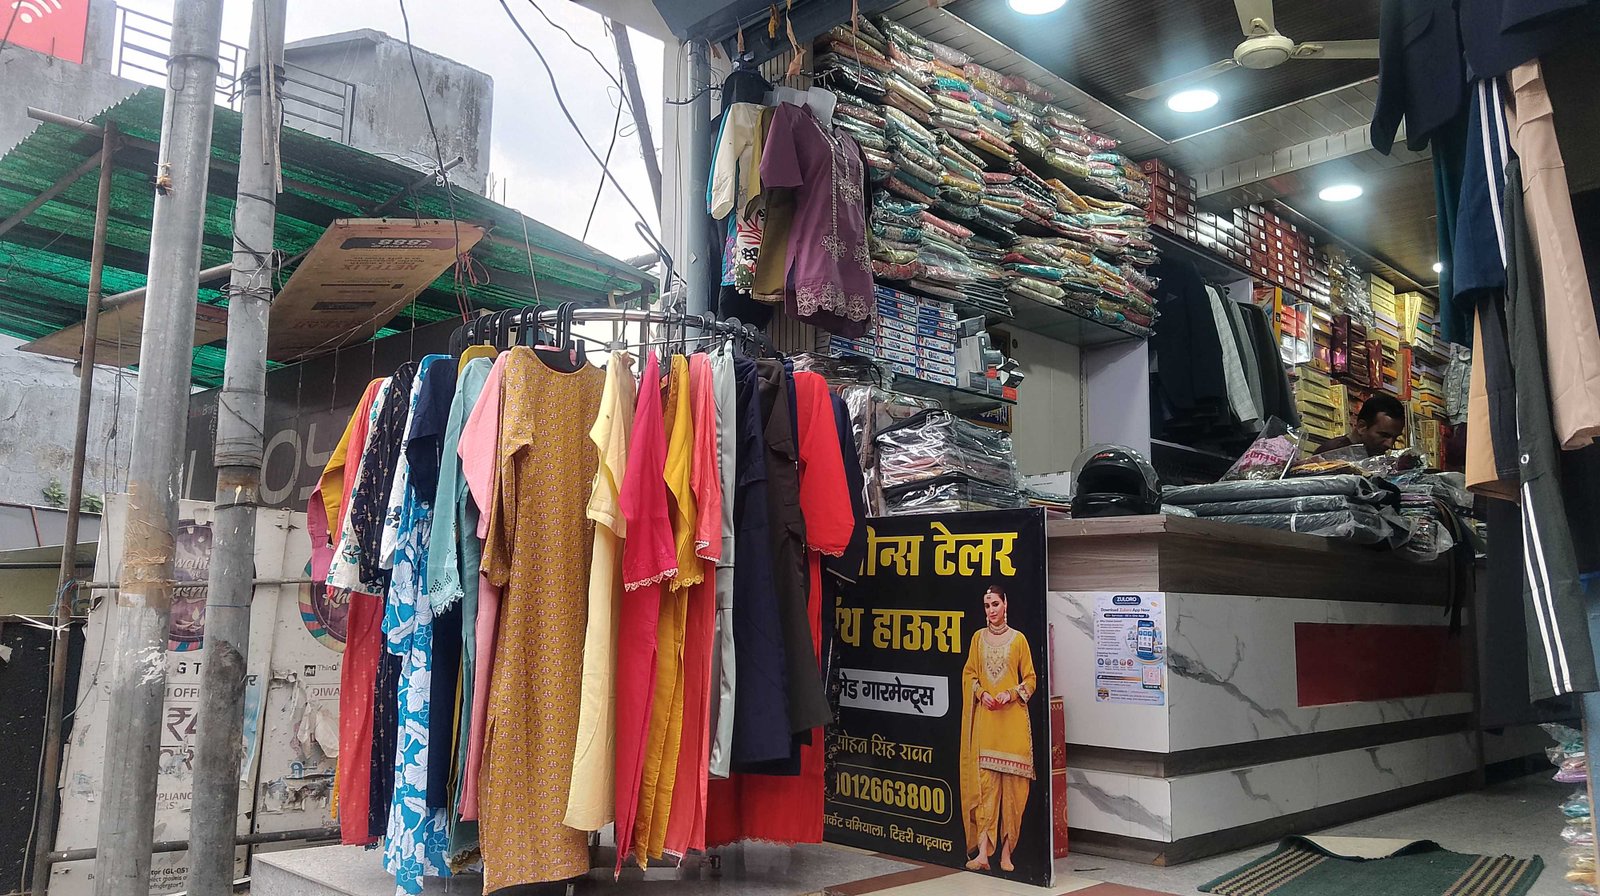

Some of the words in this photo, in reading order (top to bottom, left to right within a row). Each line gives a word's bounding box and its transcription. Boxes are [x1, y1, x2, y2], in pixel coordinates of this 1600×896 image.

[930, 521, 1018, 576] टेलर
[872, 608, 965, 653] हाऊस
[870, 733, 897, 759] सिंह
[899, 743, 933, 764] रावत
[845, 816, 887, 838] चमियाला,
[889, 823, 914, 843] टिहरी
[916, 833, 953, 852] गढ़वाल
